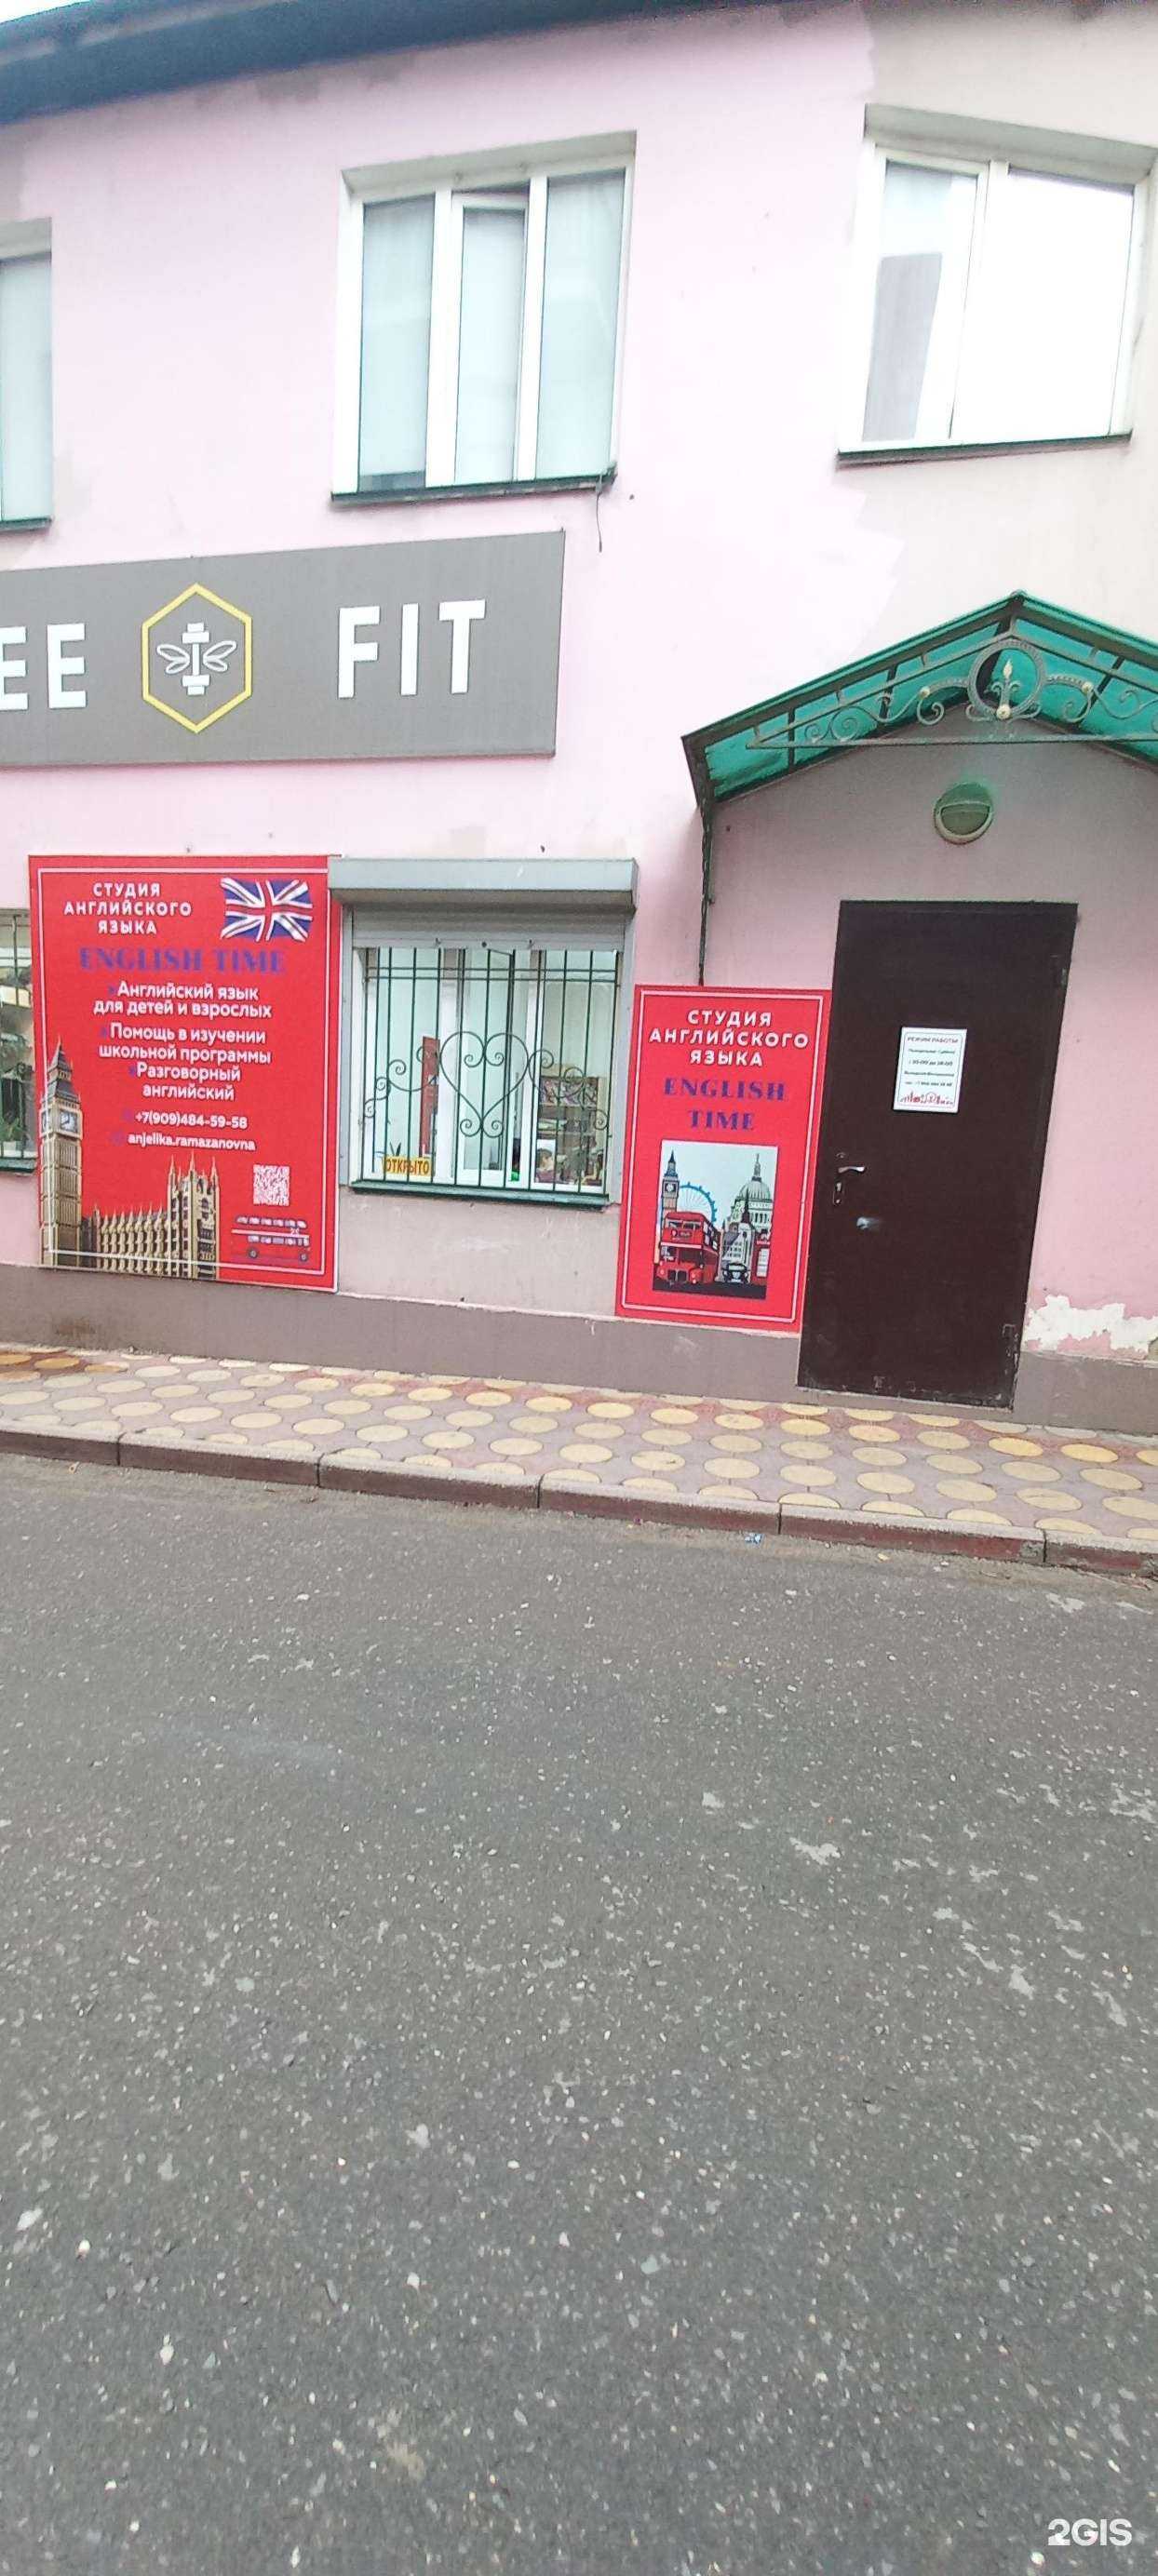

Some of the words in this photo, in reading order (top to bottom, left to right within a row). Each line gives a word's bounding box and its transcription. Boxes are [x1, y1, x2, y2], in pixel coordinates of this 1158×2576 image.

[338, 599, 486, 698] FIT
[93, 882, 160, 899] СТУДИЯ
[64, 899, 192, 917] АНГЛИЙСКОГО
[98, 919, 157, 935] ЯЗЫКА
[79, 947, 204, 972] ENGLISH
[214, 947, 285, 973] TIME
[117, 980, 213, 1000] Английский
[218, 986, 259, 1000] язык
[93, 1000, 124, 1015] для
[127, 1000, 173, 1015] детей
[178, 1002, 187, 1015] и
[192, 1003, 272, 1019] взрослых
[687, 1010, 773, 1027] СТУДИЯ
[110, 1022, 175, 1041] Помощь
[179, 1028, 187, 1040] в
[191, 1028, 266, 1045] изучении
[649, 1027, 809, 1048] АНГЛИЙСКОГО
[99, 1044, 177, 1060] школьной
[180, 1048, 271, 1066] программы
[690, 1049, 763, 1067] ЯЗЫКА
[136, 1061, 241, 1082] Разговорный
[142, 1083, 235, 1100] английский
[665, 1078, 786, 1101] ENGLISH
[135, 1110, 249, 1129] +7(909)484-59-58
[689, 1108, 755, 1131] TIME
[128, 1132, 256, 1151] anjelika.ramazanovna
[384, 1158, 430, 1174] ОТКРЫТО
